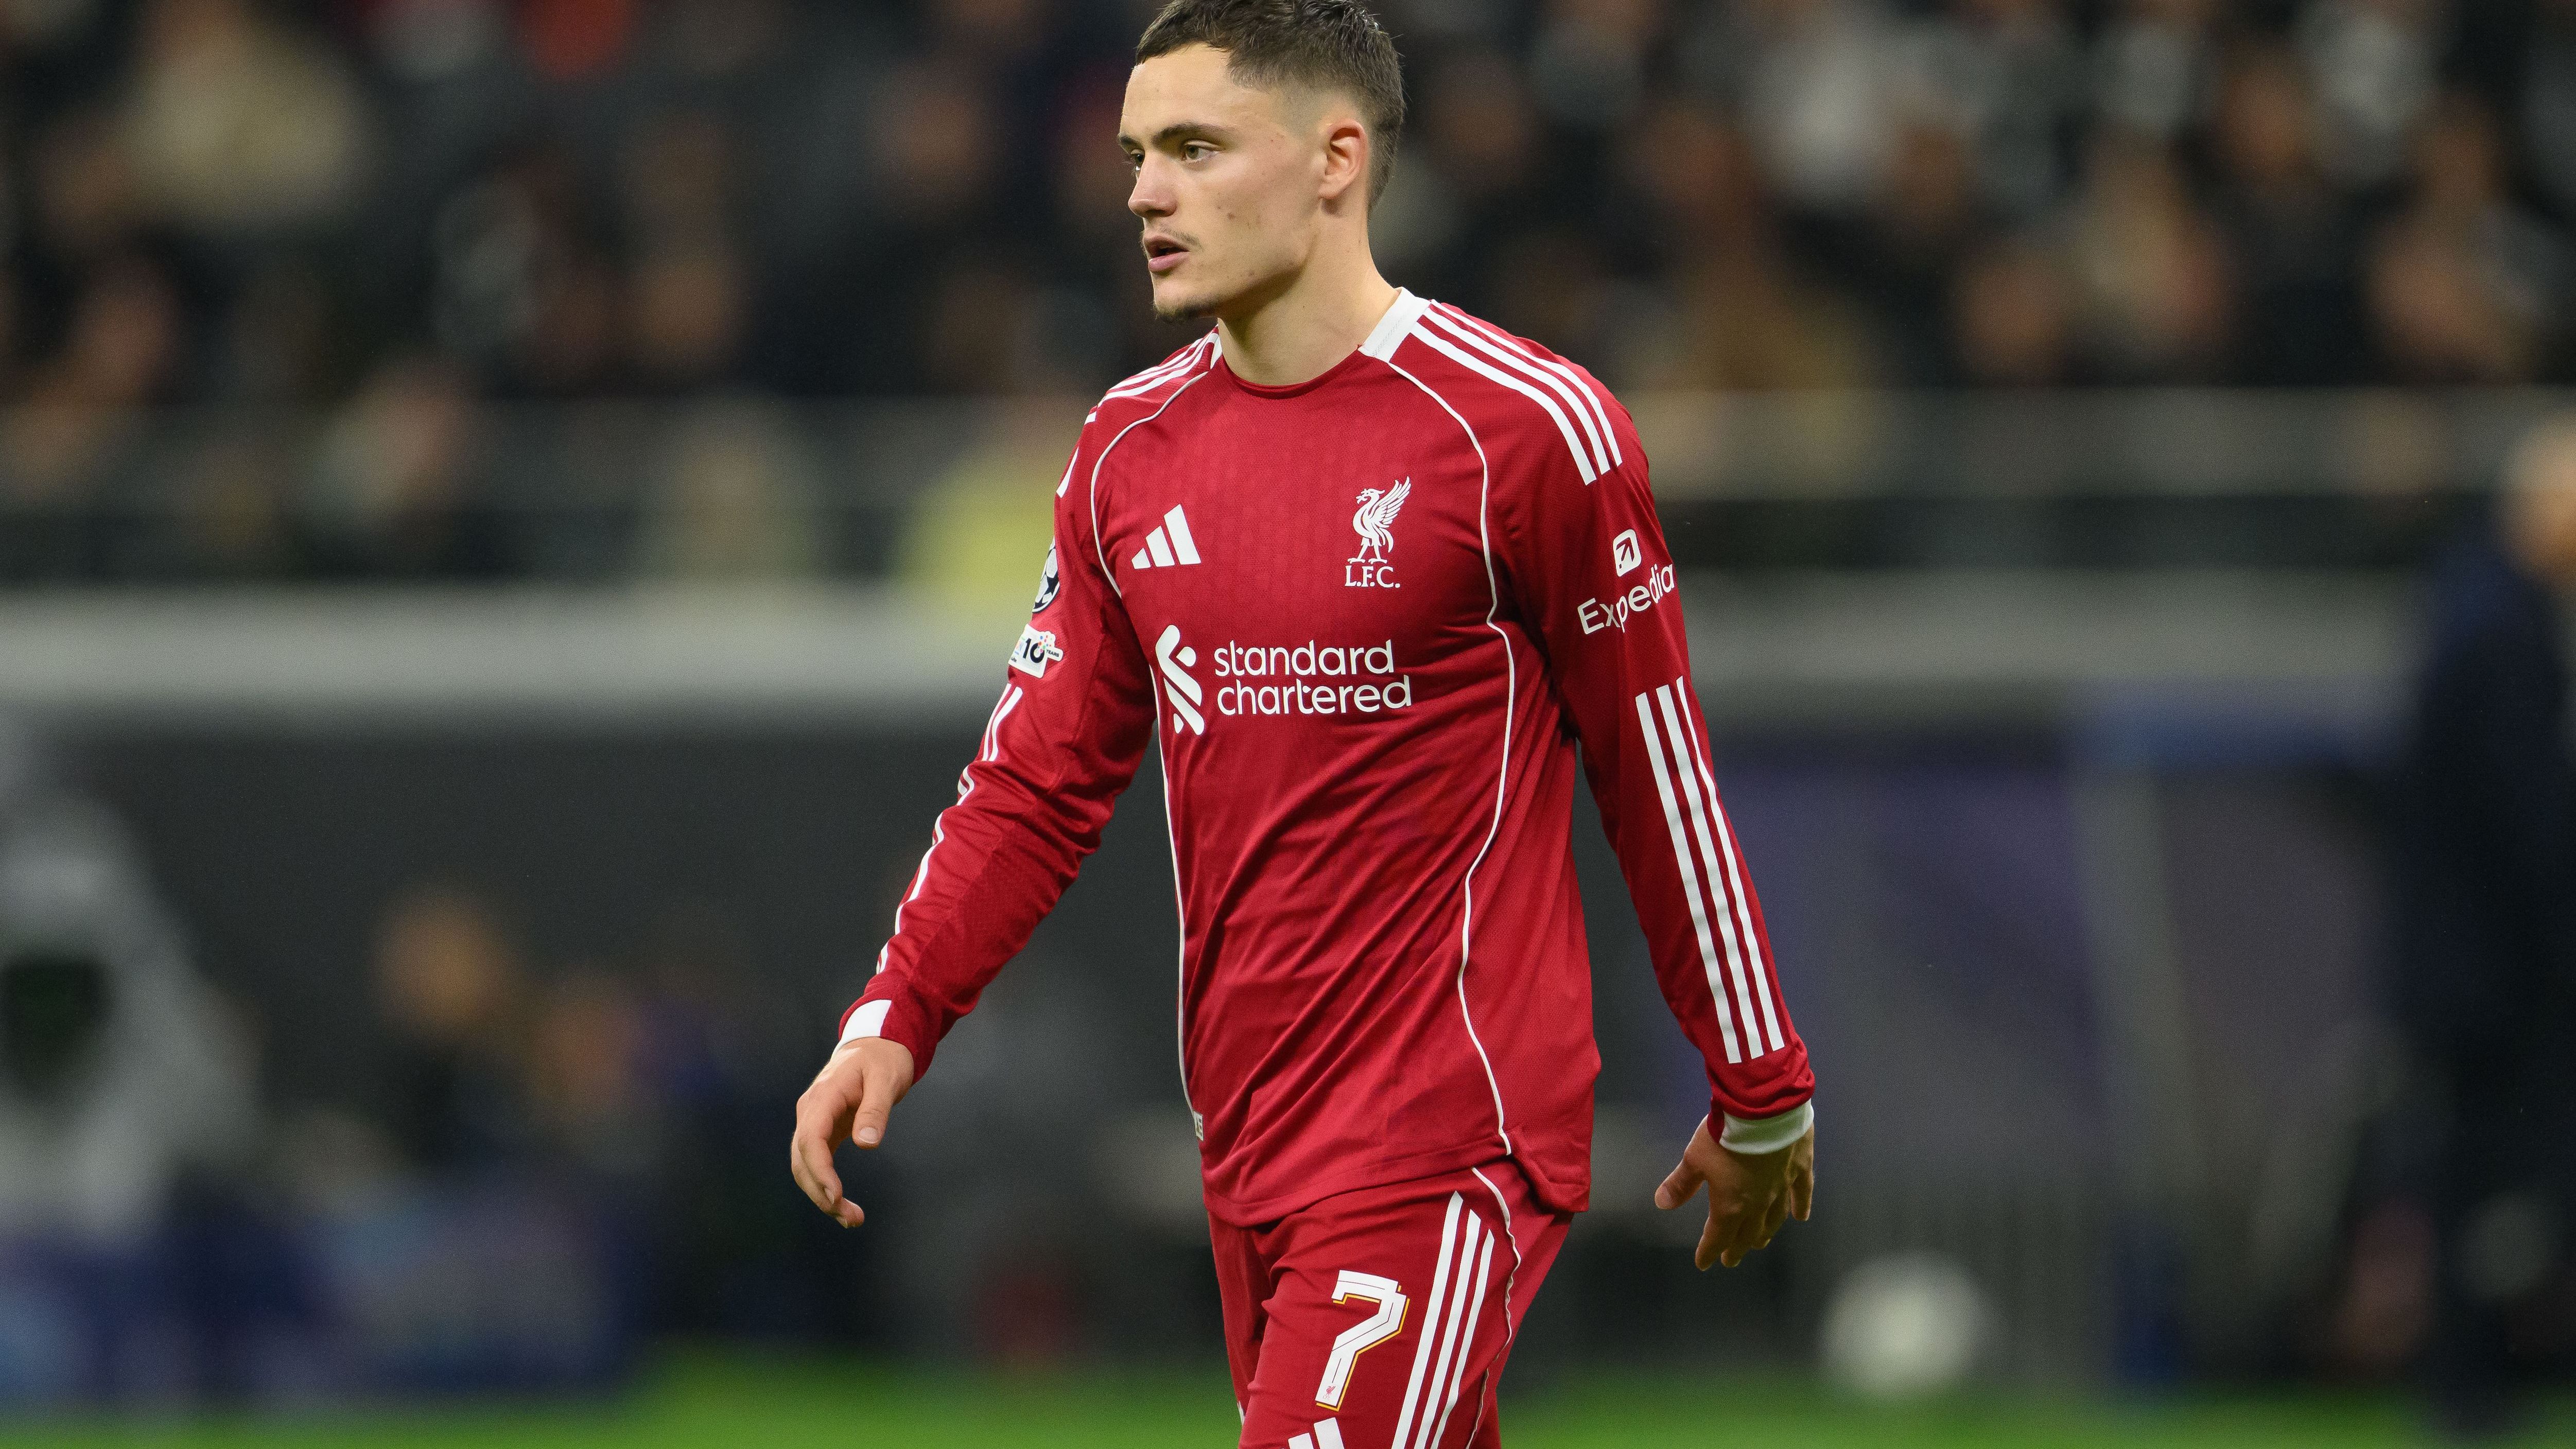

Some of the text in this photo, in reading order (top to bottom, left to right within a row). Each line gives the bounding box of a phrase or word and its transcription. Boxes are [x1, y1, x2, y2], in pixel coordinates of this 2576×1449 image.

[1344, 565, 1400, 588] L.F.C.
[1577, 564, 1675, 635] Expedia
[1023, 638, 1059, 663] 10 YEARS
[1214, 639, 1395, 676] standard
[1217, 675, 1412, 715] chartered
[1315, 1269, 1410, 1411] 7
